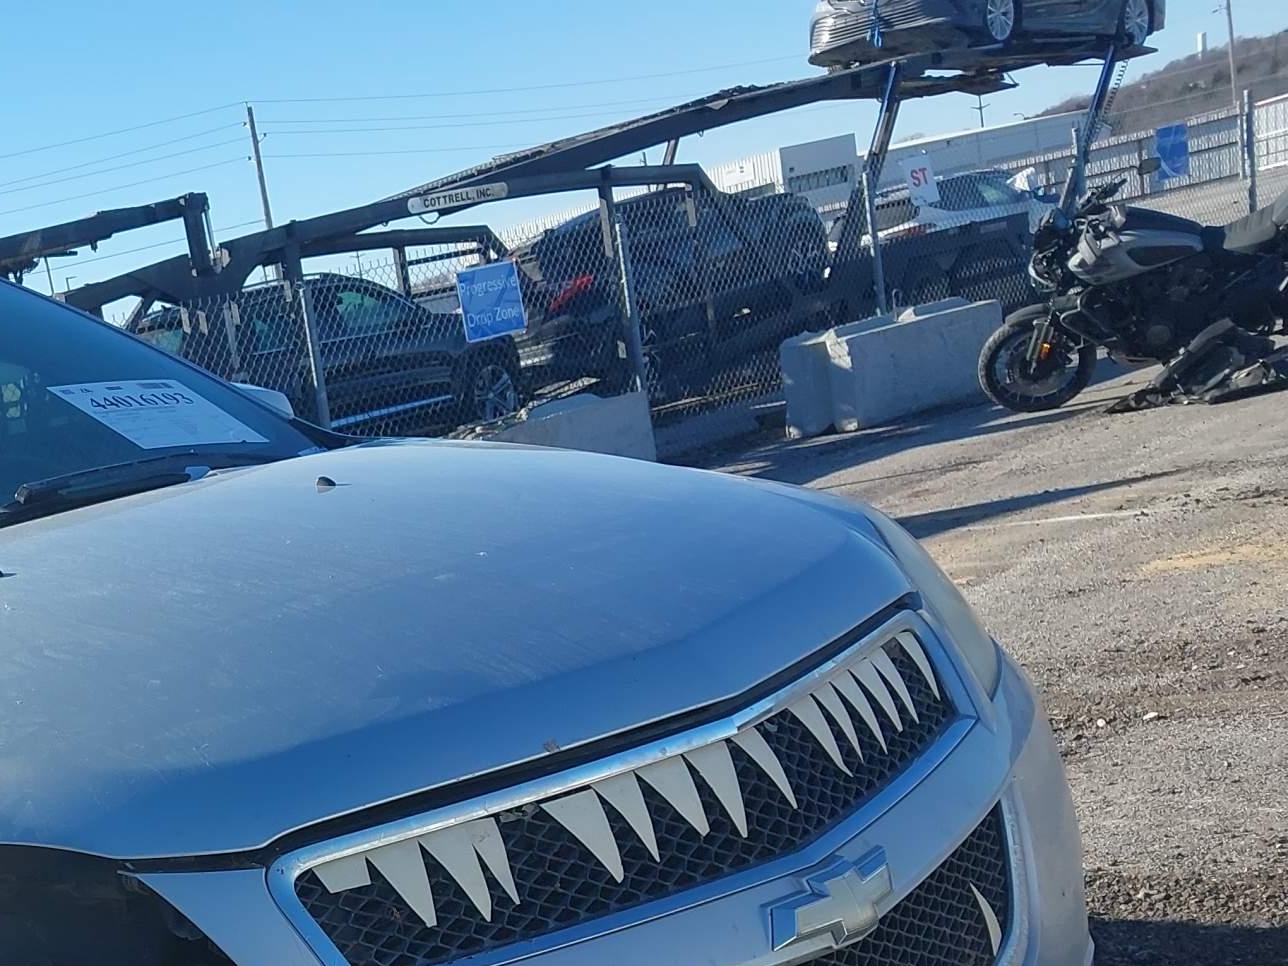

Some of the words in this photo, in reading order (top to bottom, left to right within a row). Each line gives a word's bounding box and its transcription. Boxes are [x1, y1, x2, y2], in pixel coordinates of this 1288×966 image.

[910, 167, 928, 188] ST
[476, 188, 495, 199] INC.
[460, 275, 517, 297] Progressive
[467, 311, 494, 328] Drop
[495, 305, 521, 320] Zone
[90, 391, 194, 410] 44016193
